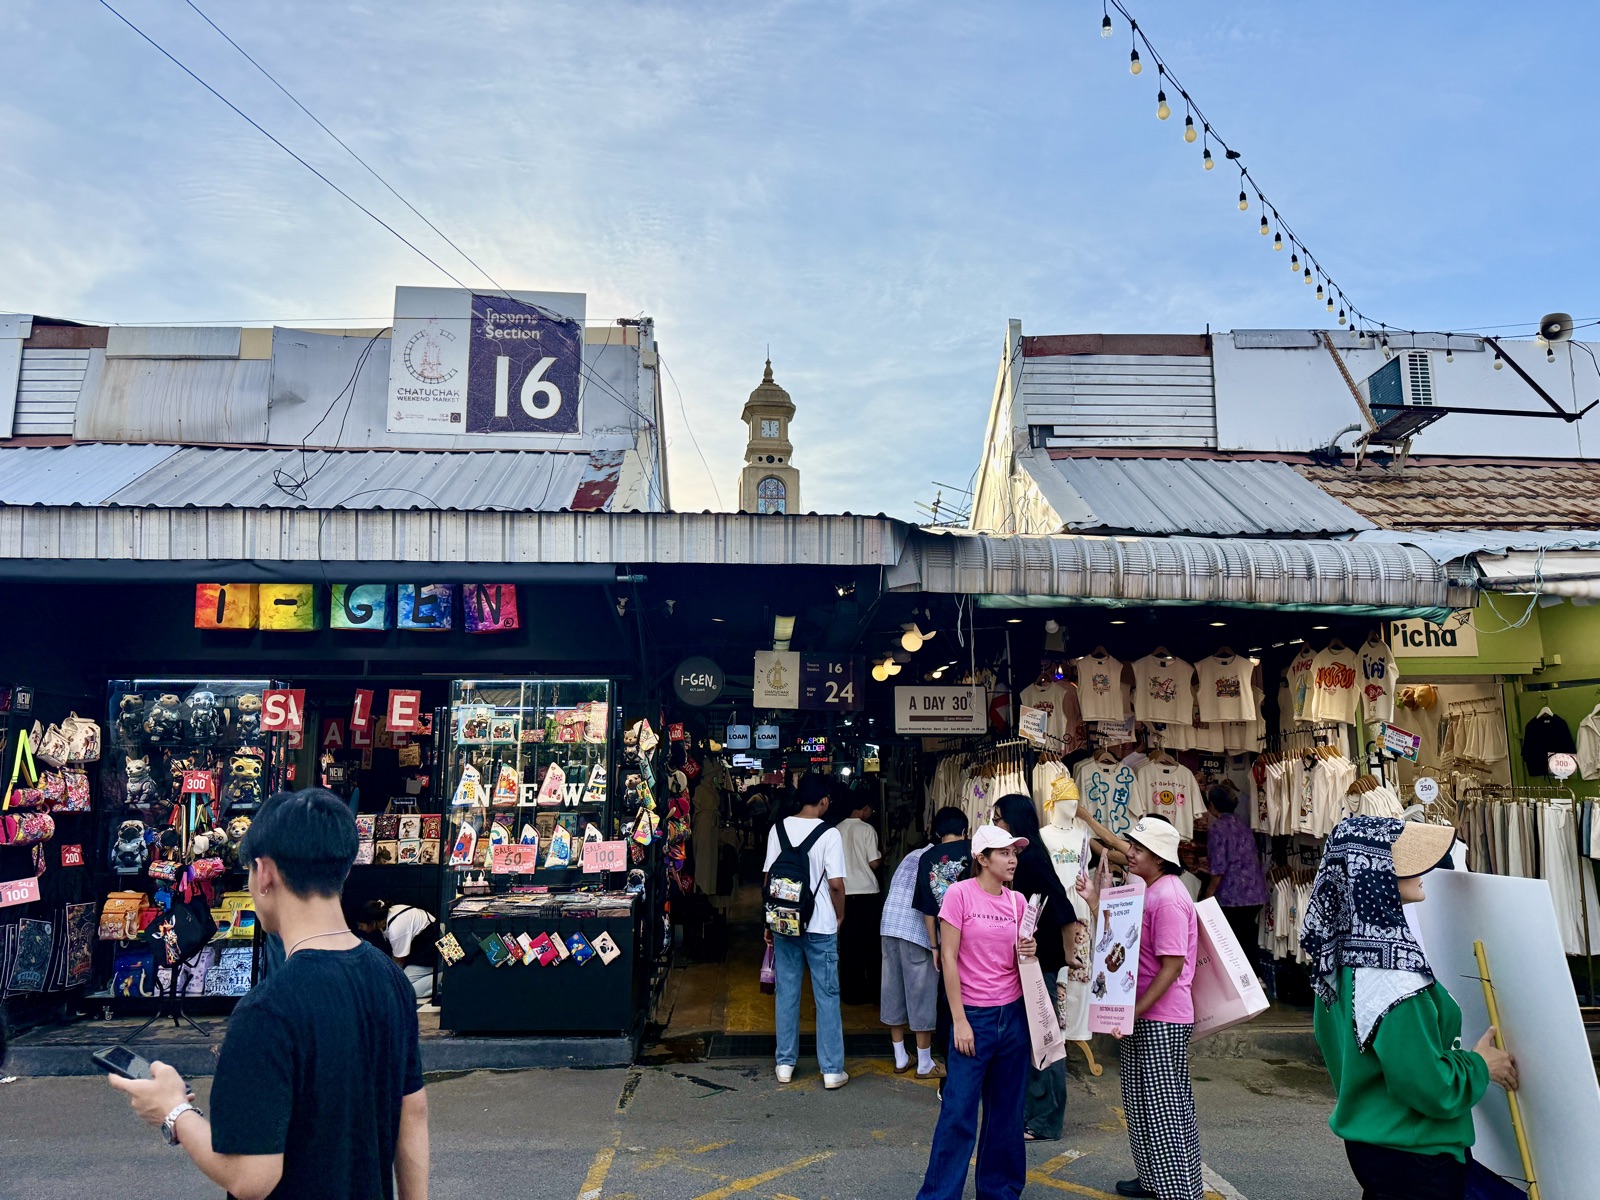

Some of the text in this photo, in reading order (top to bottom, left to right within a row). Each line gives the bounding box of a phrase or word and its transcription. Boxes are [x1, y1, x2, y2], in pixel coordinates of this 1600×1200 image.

[486, 325, 540, 340] Section
[397, 388, 460, 396] CHATUCHAK
[495, 356, 562, 420] 16
[828, 662, 842, 674] 16
[16, 692, 31, 704] NEW
[825, 681, 854, 703] 24
[909, 696, 918, 710] A
[924, 696, 946, 710] DAY
[671, 730, 682, 738] 400
[330, 767, 344, 776] NEW
[187, 779, 205, 790] 300
[472, 783, 585, 807] NEW
[494, 846, 512, 856] SALE
[585, 844, 601, 854] SALE
[65, 853, 79, 863] 200
[6, 888, 28, 901] 100
